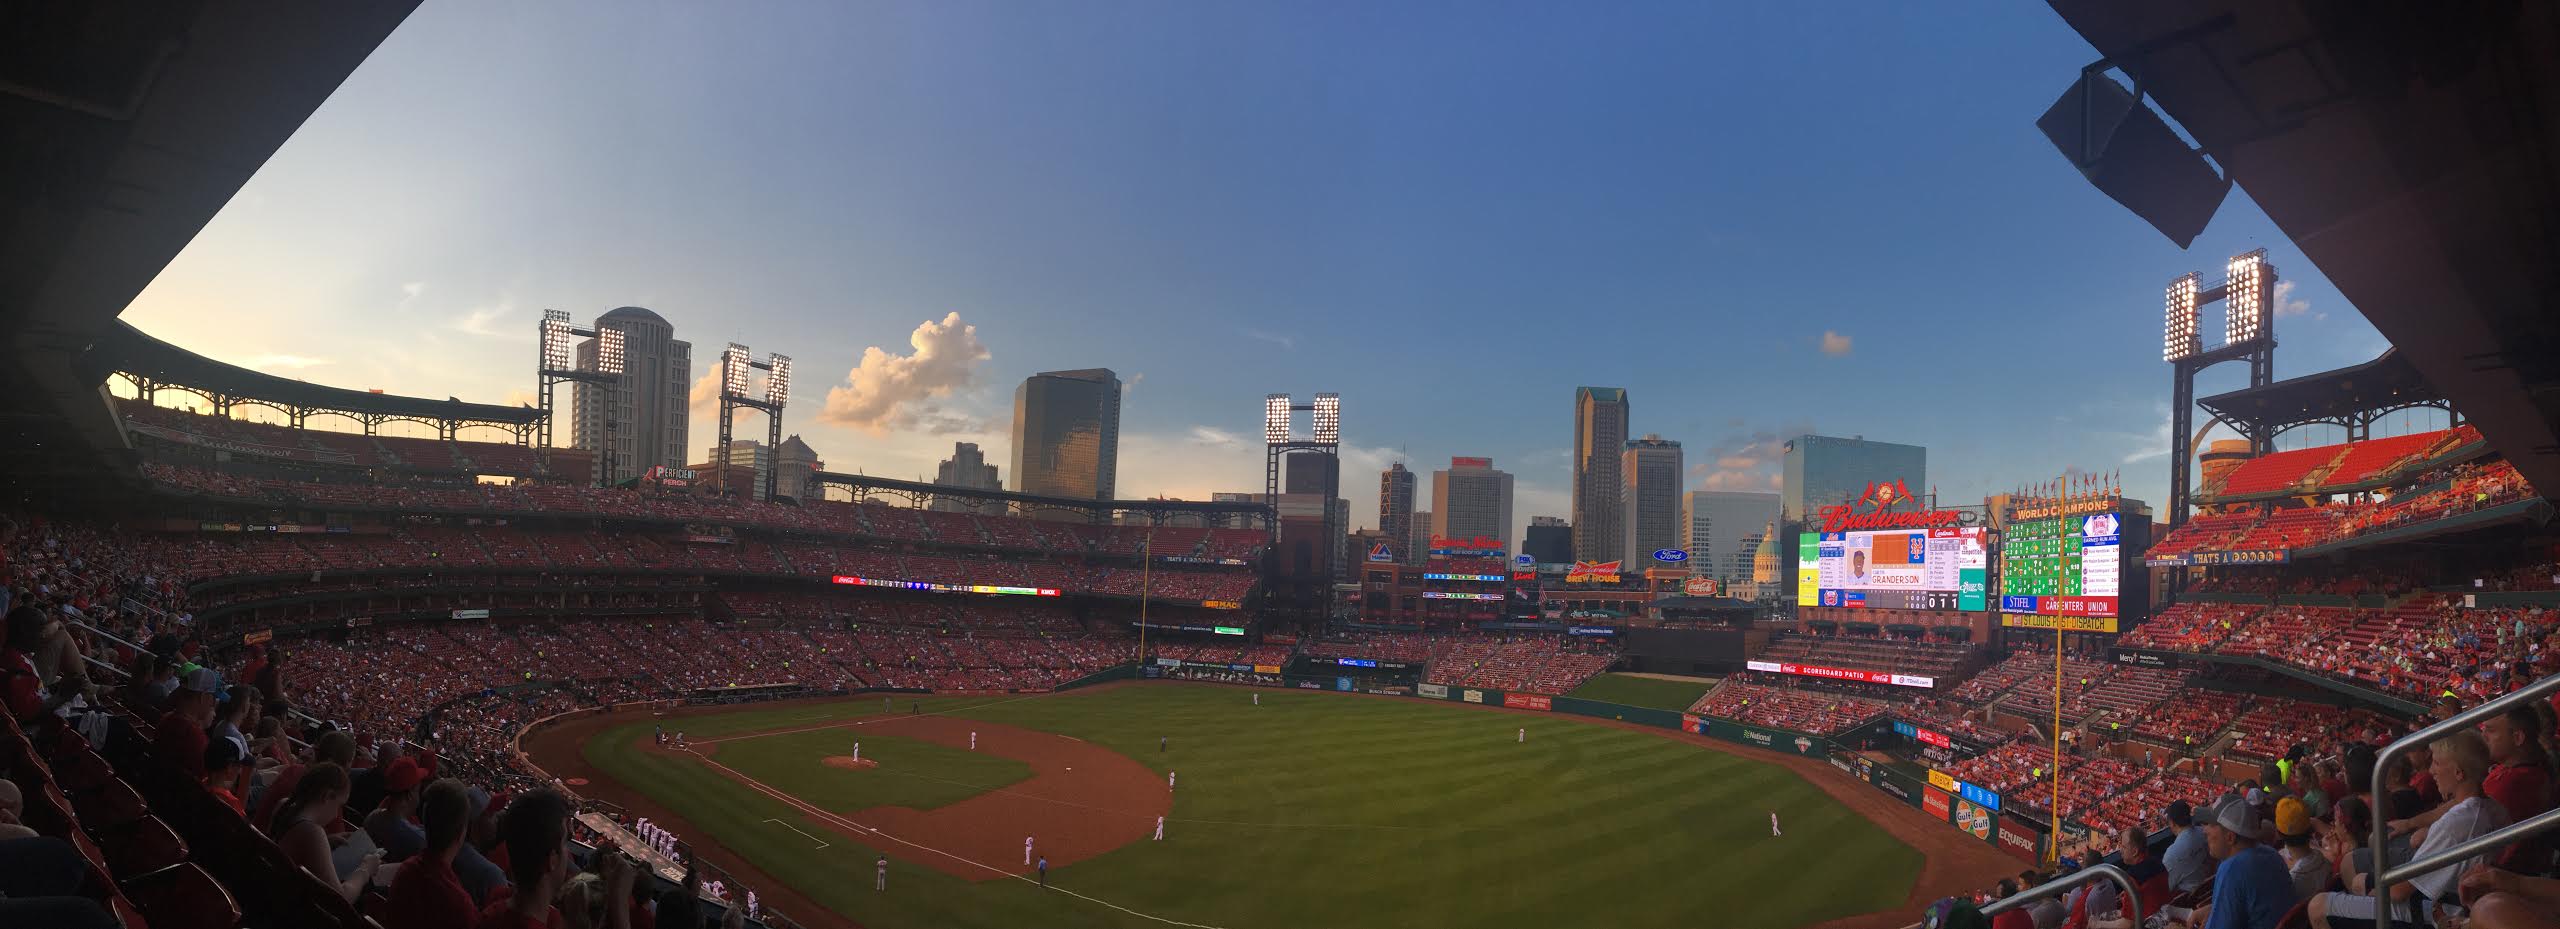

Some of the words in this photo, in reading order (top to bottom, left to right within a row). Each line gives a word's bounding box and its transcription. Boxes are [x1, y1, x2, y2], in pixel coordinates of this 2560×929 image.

[655, 465, 696, 479] PERFICIENT
[662, 478, 687, 487] PERCH
[1819, 502, 1962, 534] Budweiser
[2017, 509, 2049, 520] WORLD
[1659, 550, 1682, 560] Ford
[2193, 553, 2220, 564] THAT'S
[2222, 553, 2229, 563] A
[2231, 550, 2275, 562] POWER
[1566, 574, 1590, 583] BREW
[1591, 575, 1621, 583] HOUSE
[1872, 575, 1920, 584] GRANDERSON
[1929, 598, 1935, 608] 0
[2009, 596, 2029, 608] STIFEL
[2087, 602, 2108, 612] UNION
[2032, 616, 2051, 627] LOUIS
[2052, 616, 2105, 630] PST-DISPATCH
[2120, 654, 2134, 664] Mercy
[1803, 667, 1843, 677] SCOREBOARD
[1844, 670, 1864, 679] PATIO
[1749, 731, 1772, 741] National
[1957, 811, 1971, 821] Gulf
[1973, 819, 1988, 829] Gulf
[1998, 827, 2035, 852] EQUIFAX
